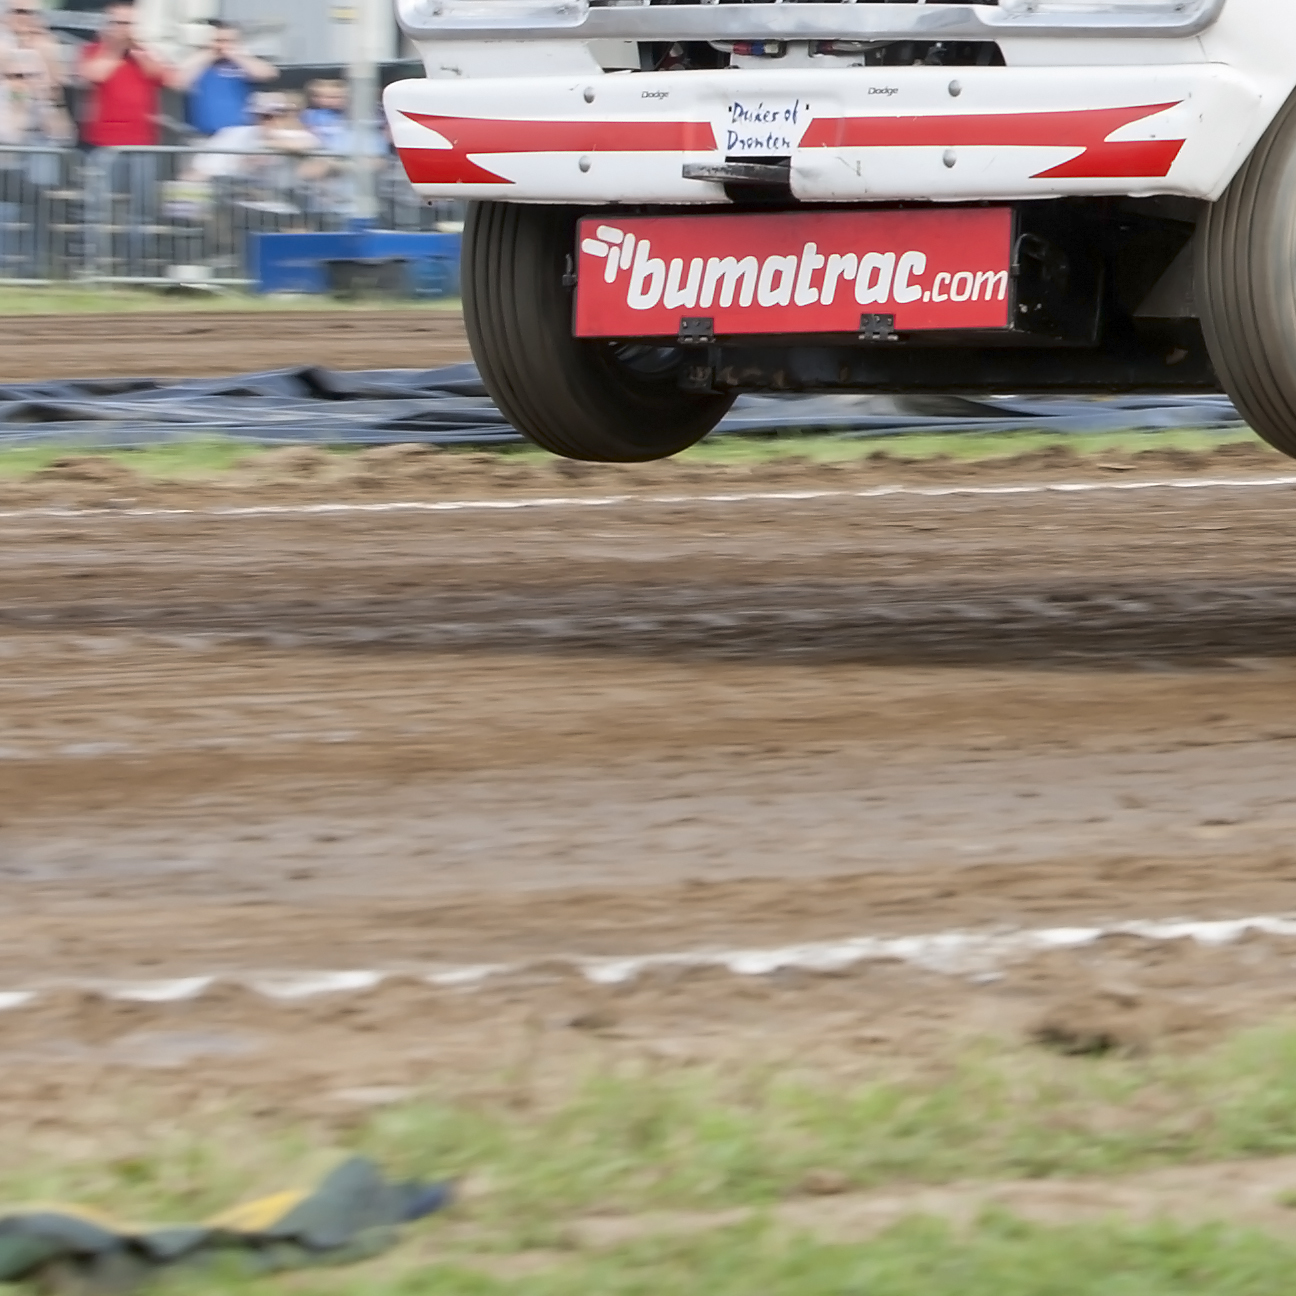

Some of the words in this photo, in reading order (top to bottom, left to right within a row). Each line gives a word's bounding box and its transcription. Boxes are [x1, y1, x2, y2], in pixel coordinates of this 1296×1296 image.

[641, 90, 669, 100] Dodge
[867, 87, 899, 96] Dodge
[627, 239, 1009, 310] bumatrac.com
